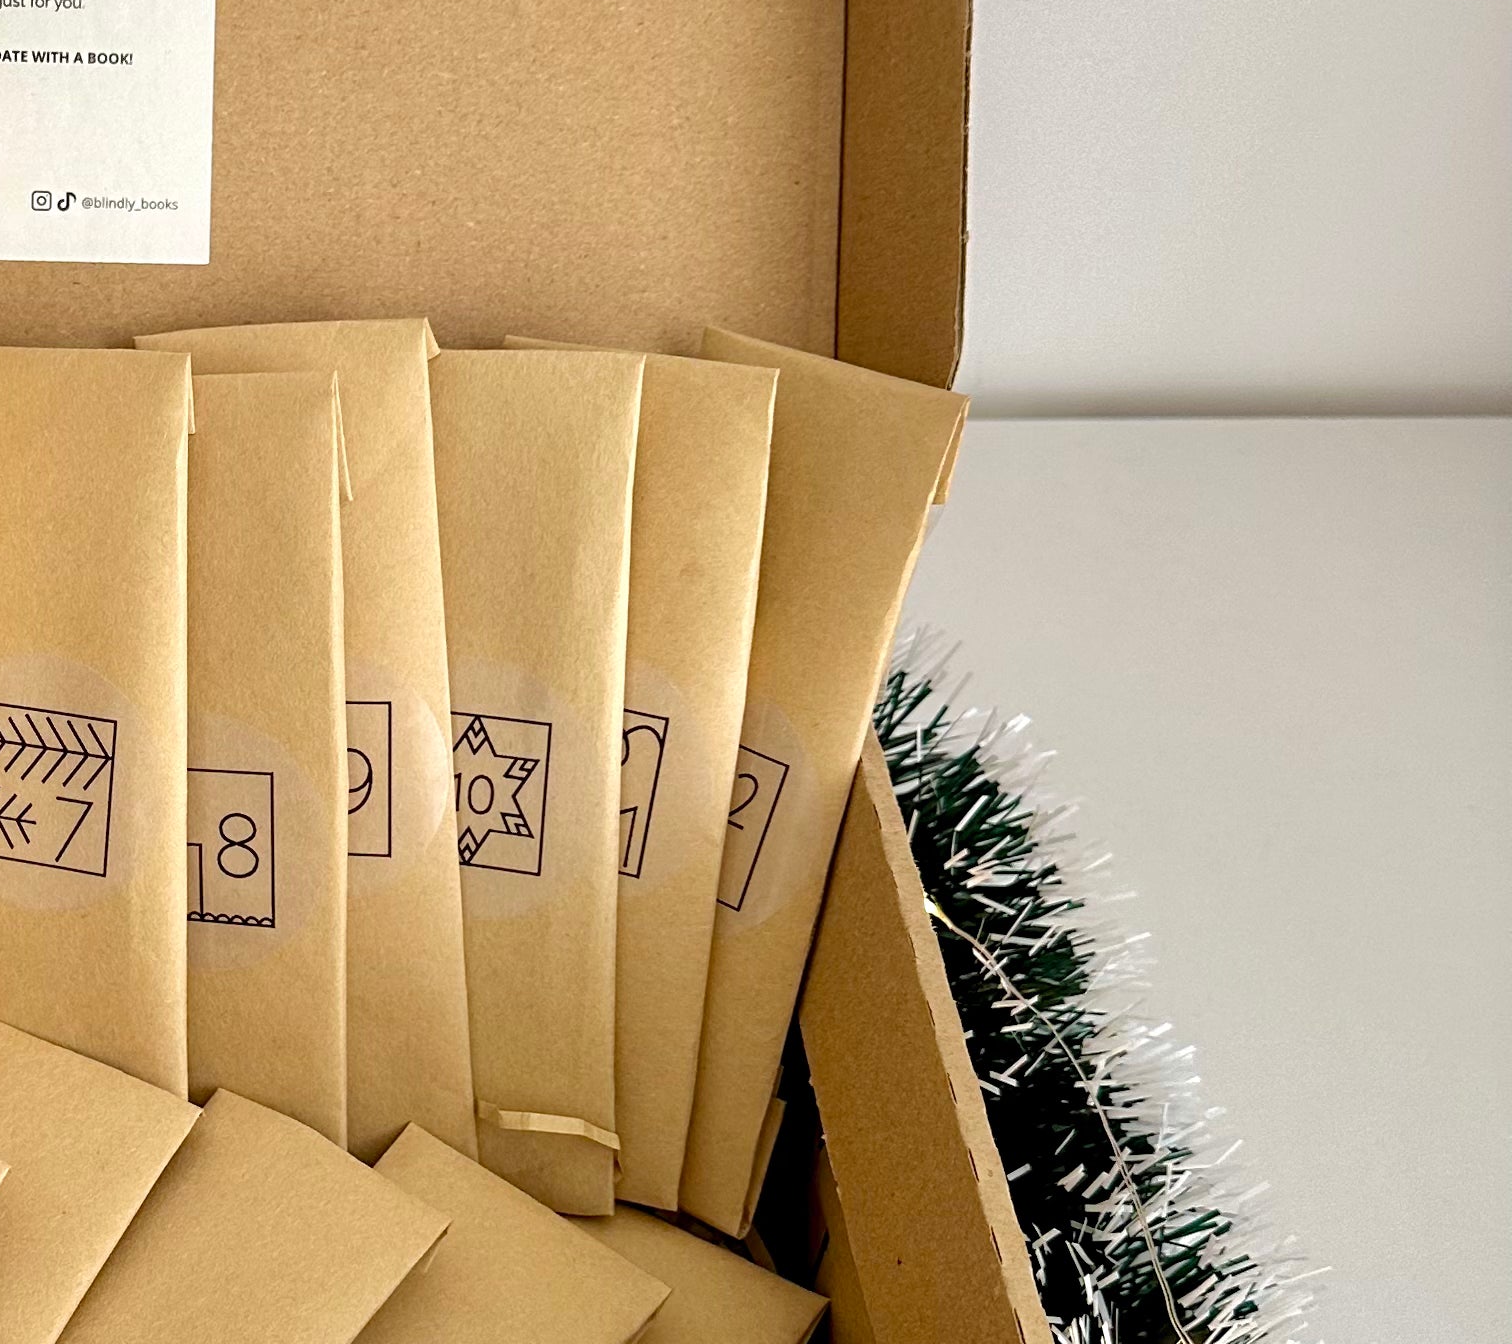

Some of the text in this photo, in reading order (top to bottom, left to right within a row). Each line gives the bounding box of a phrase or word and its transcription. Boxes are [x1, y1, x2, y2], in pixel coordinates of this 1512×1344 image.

[31, 50, 70, 65] WITH
[72, 51, 84, 65] A
[87, 52, 134, 66] BOOK!
[81, 196, 179, 213] @blindly_books
[453, 772, 495, 816] 10
[55, 794, 94, 863] 7
[216, 811, 261, 879] 8
